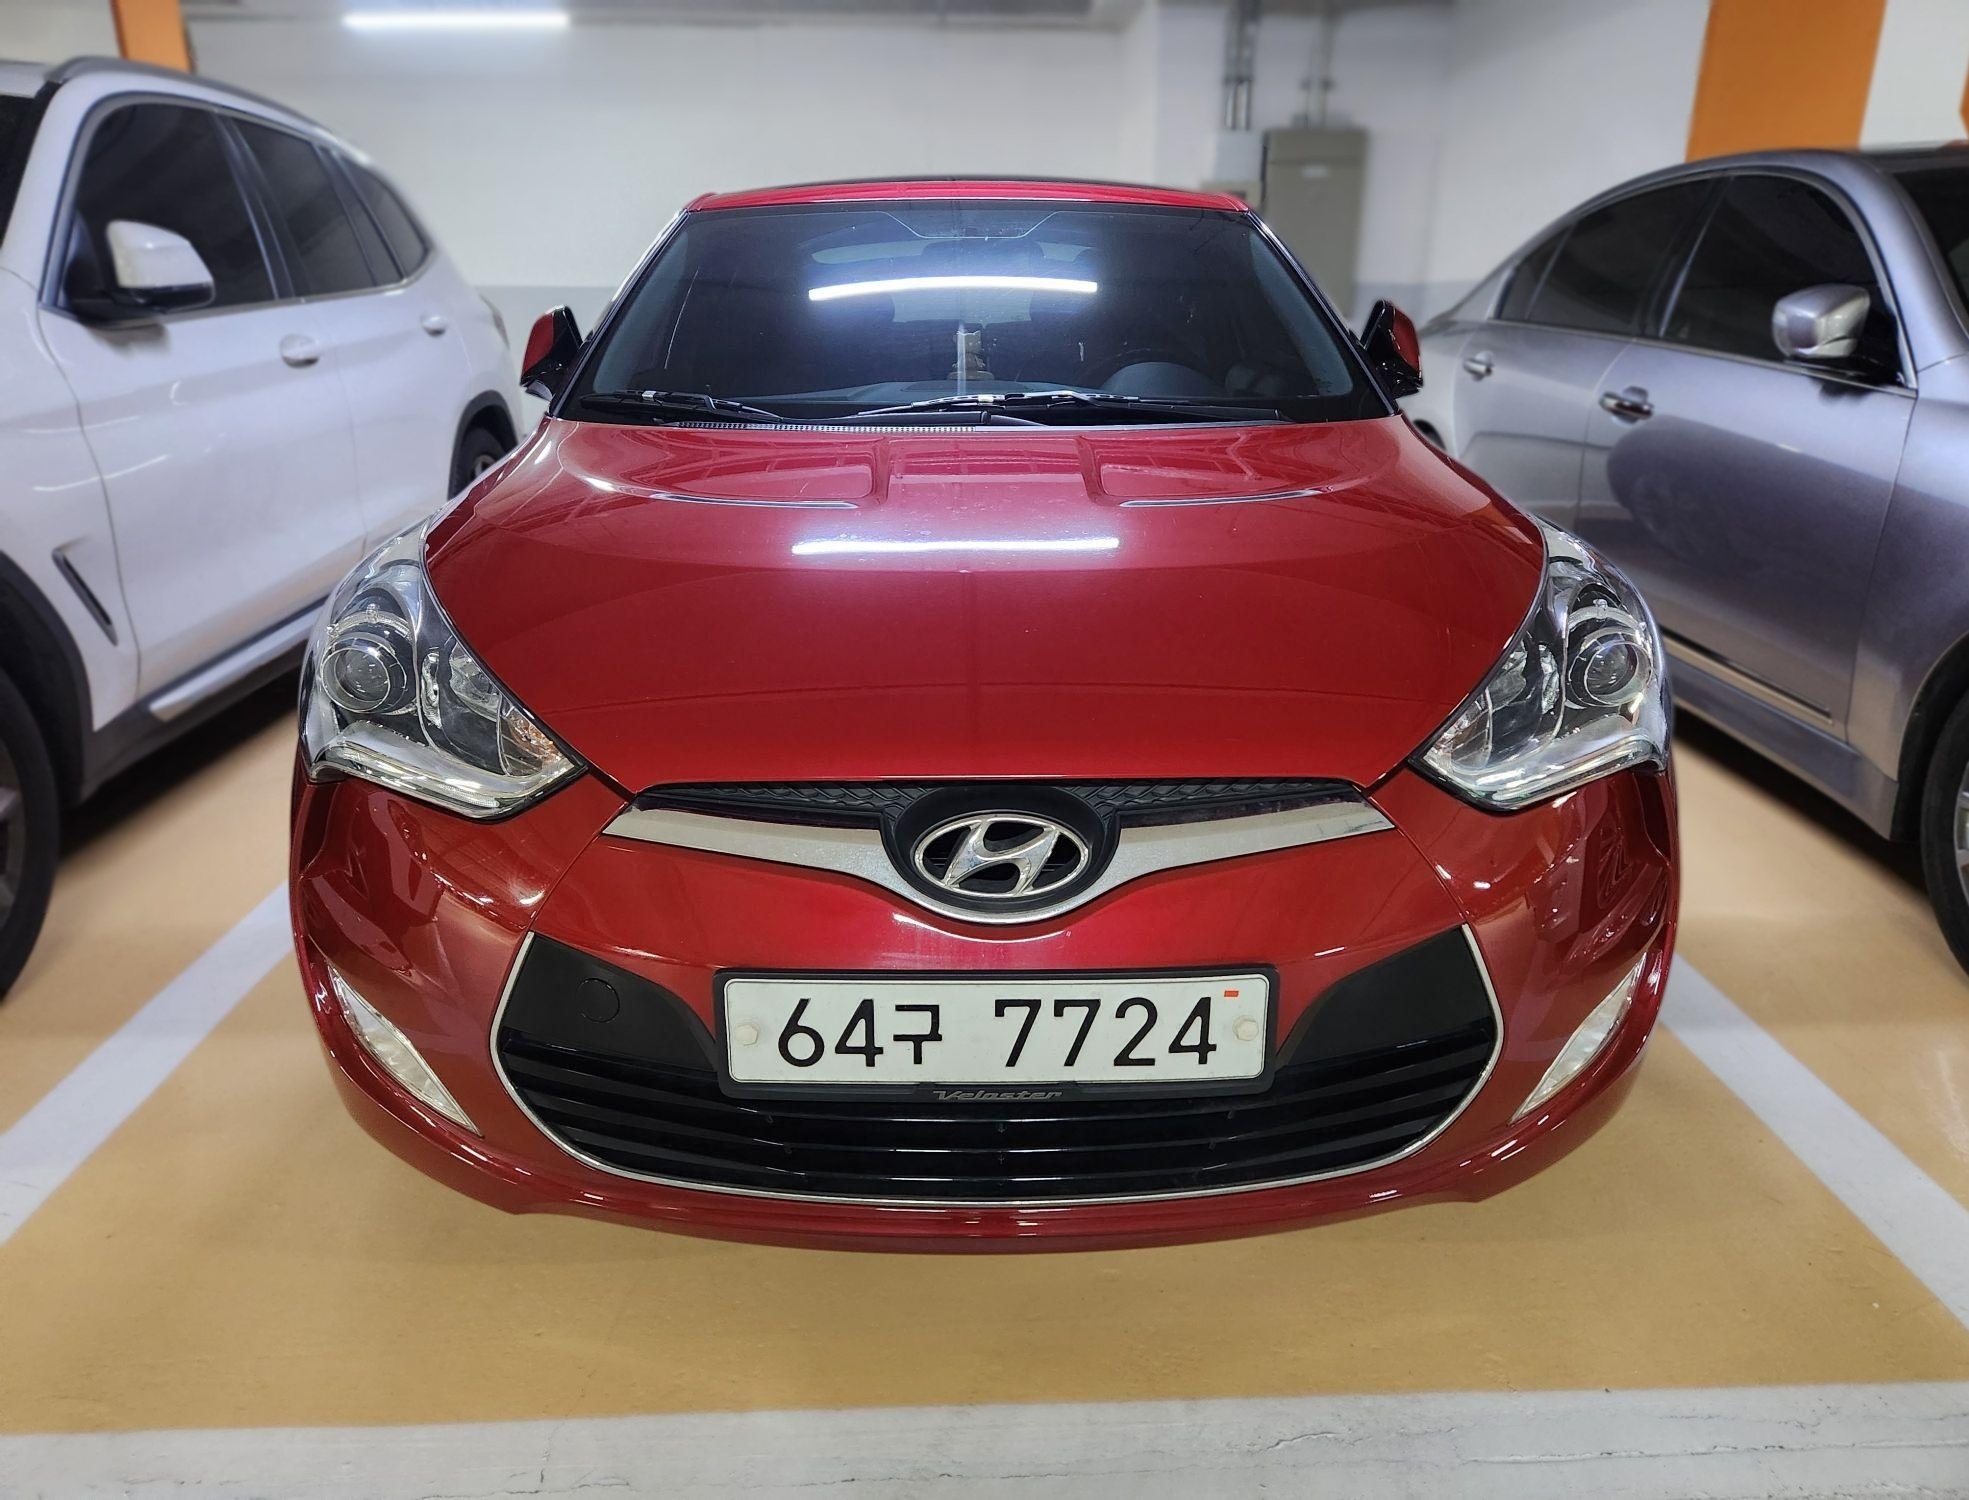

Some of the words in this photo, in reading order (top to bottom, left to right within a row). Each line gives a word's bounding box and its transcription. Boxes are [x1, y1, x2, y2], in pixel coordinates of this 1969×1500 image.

[778, 998, 943, 1068] 64구
[994, 997, 1218, 1067] 7724
[932, 1090, 1063, 1101] Veloster
